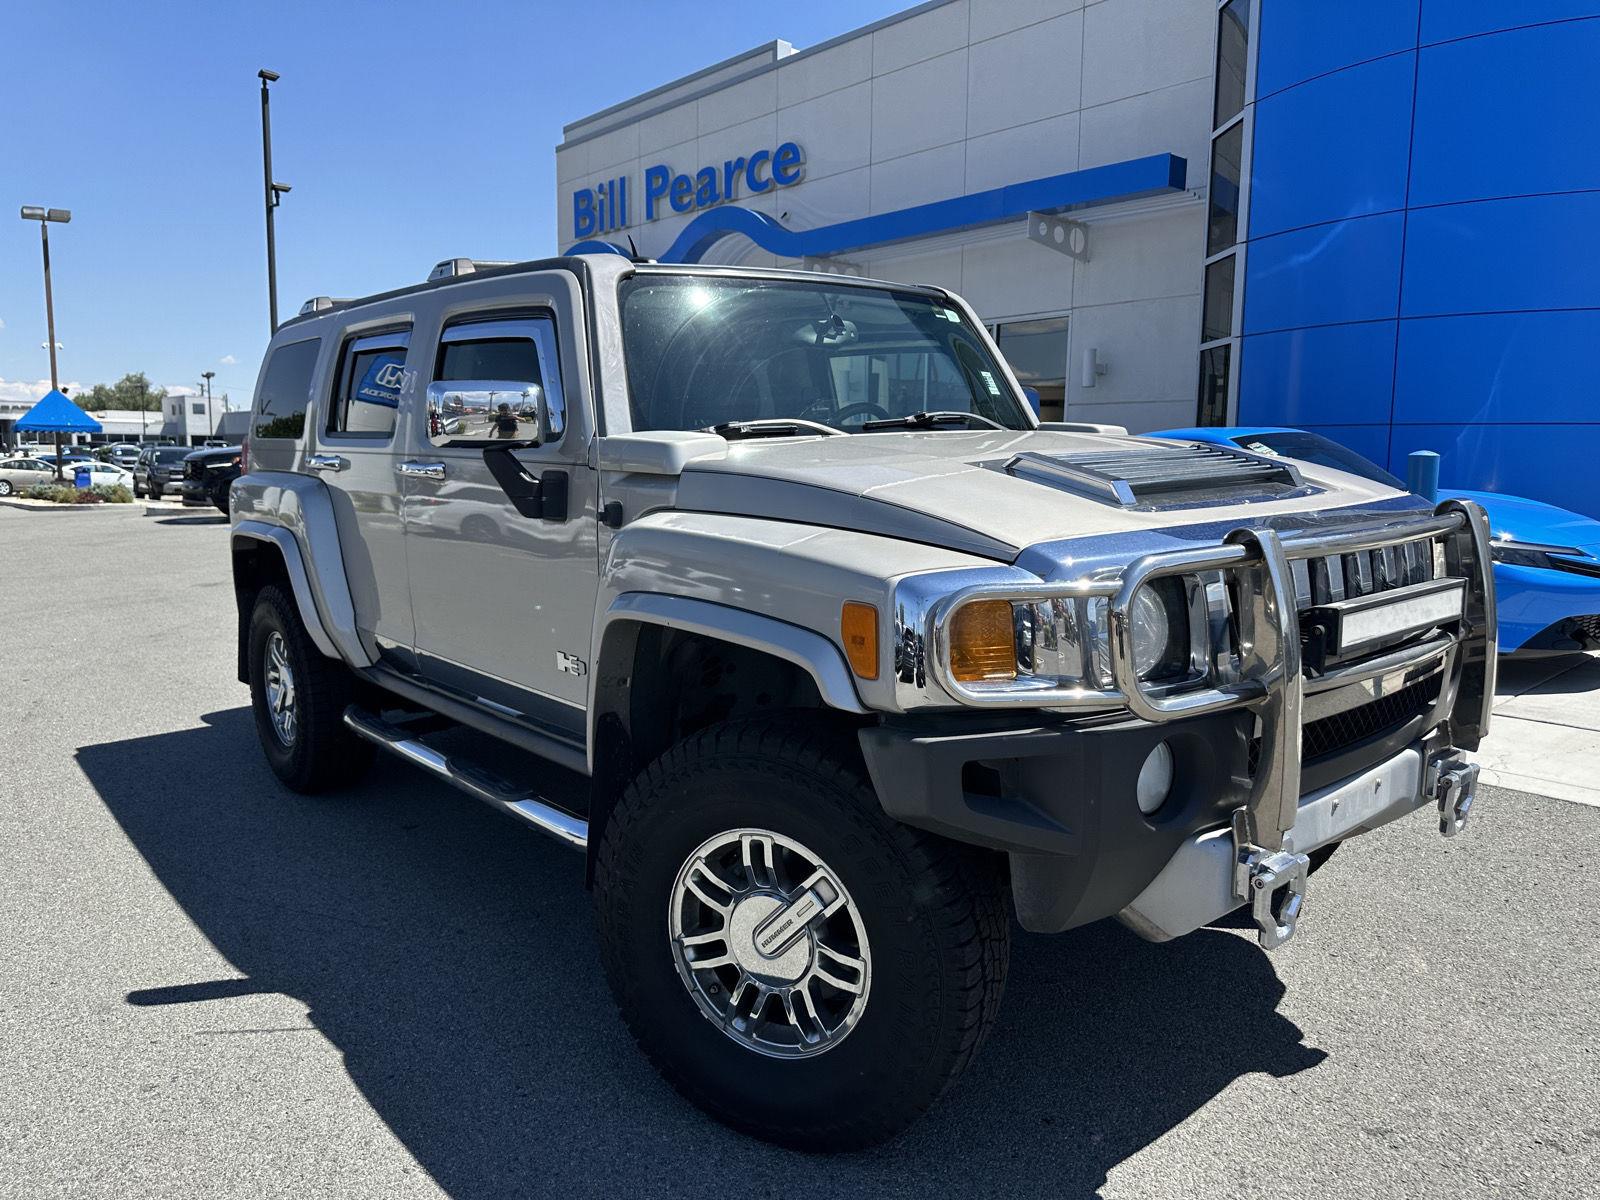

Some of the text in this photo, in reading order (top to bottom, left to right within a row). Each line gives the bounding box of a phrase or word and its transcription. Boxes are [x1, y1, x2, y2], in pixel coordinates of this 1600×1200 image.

[574, 142, 802, 239] Bill Pearce
[761, 918, 794, 948] HUMMER
